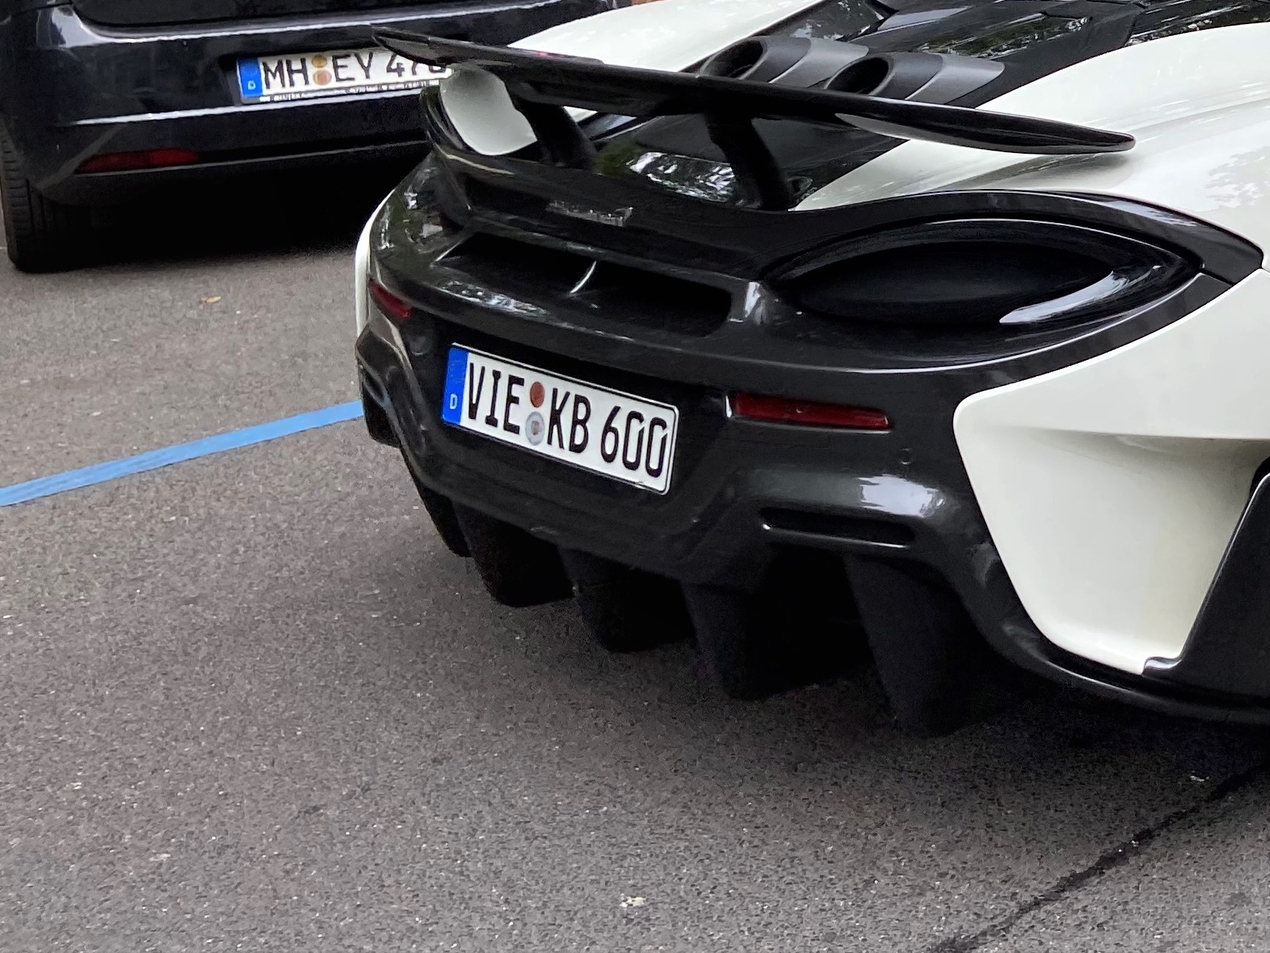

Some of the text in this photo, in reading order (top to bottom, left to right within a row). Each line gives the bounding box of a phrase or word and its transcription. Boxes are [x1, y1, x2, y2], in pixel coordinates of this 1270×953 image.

[262, 58, 310, 90] MH
[332, 52, 374, 82] EY
[449, 362, 667, 478] D VIE KB 600
